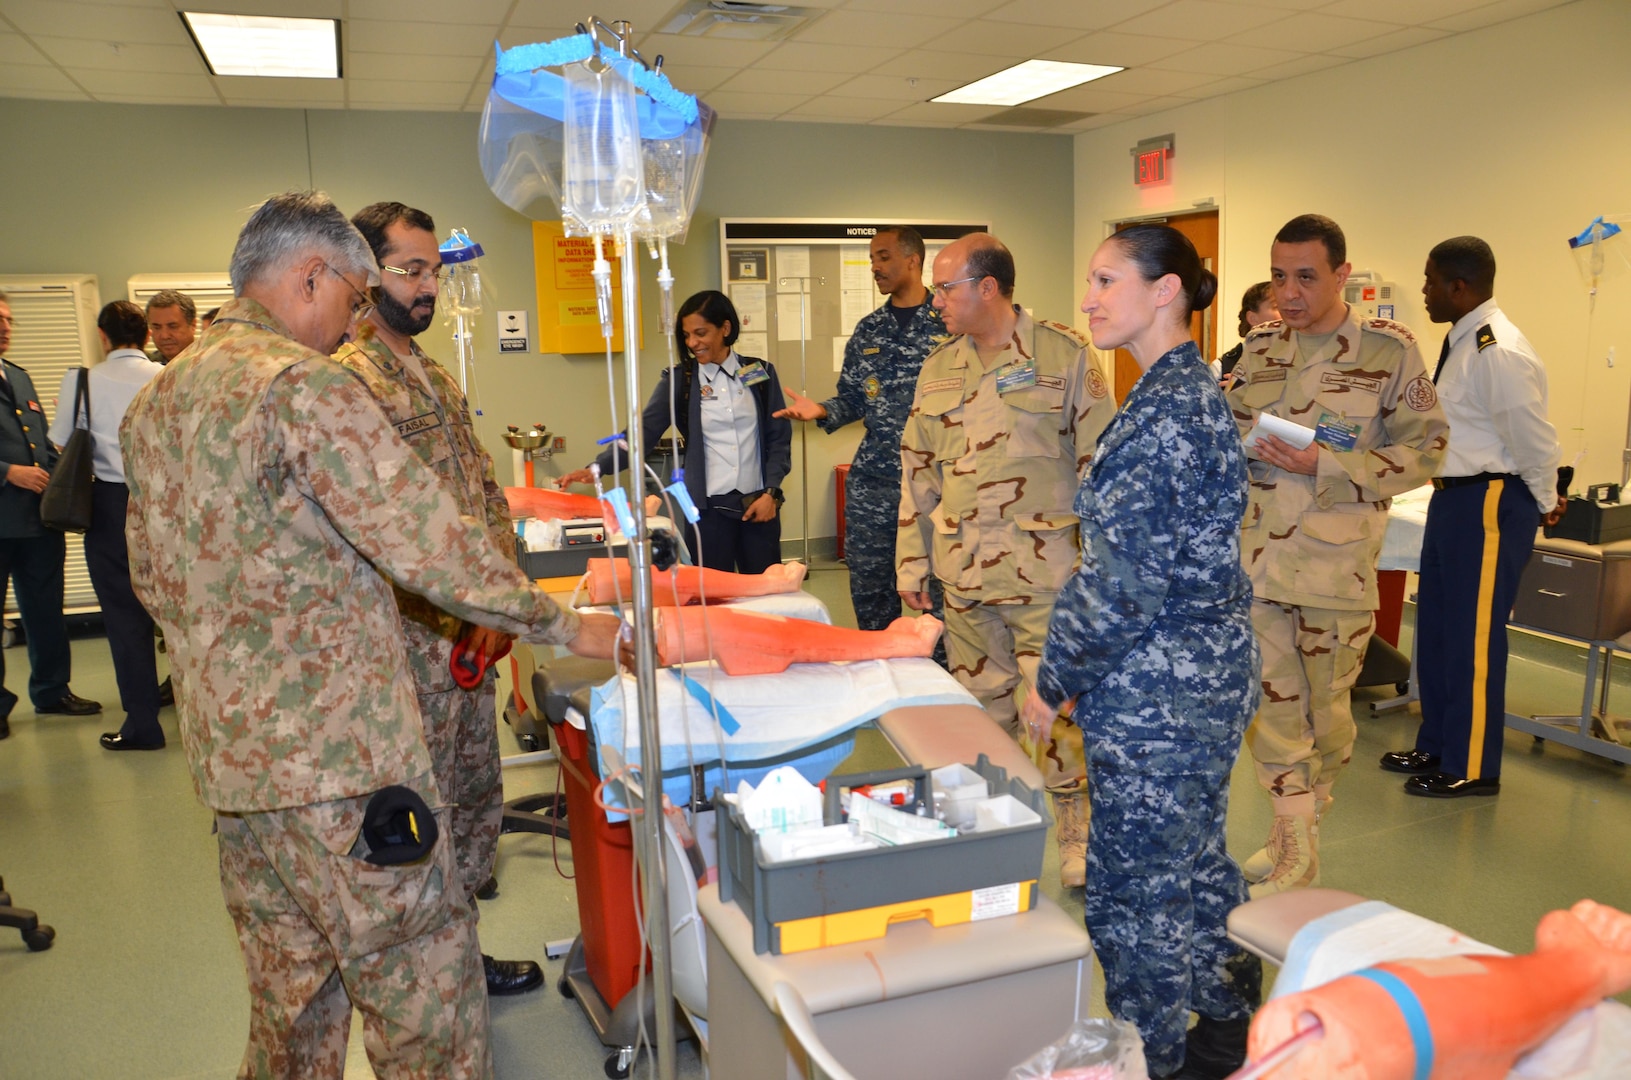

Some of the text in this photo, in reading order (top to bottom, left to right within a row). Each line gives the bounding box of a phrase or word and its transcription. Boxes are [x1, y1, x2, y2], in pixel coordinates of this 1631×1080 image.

[1139, 152, 1160, 182] EXIT
[846, 227, 877, 236] NOTICES
[398, 418, 430, 435] FAISAL
